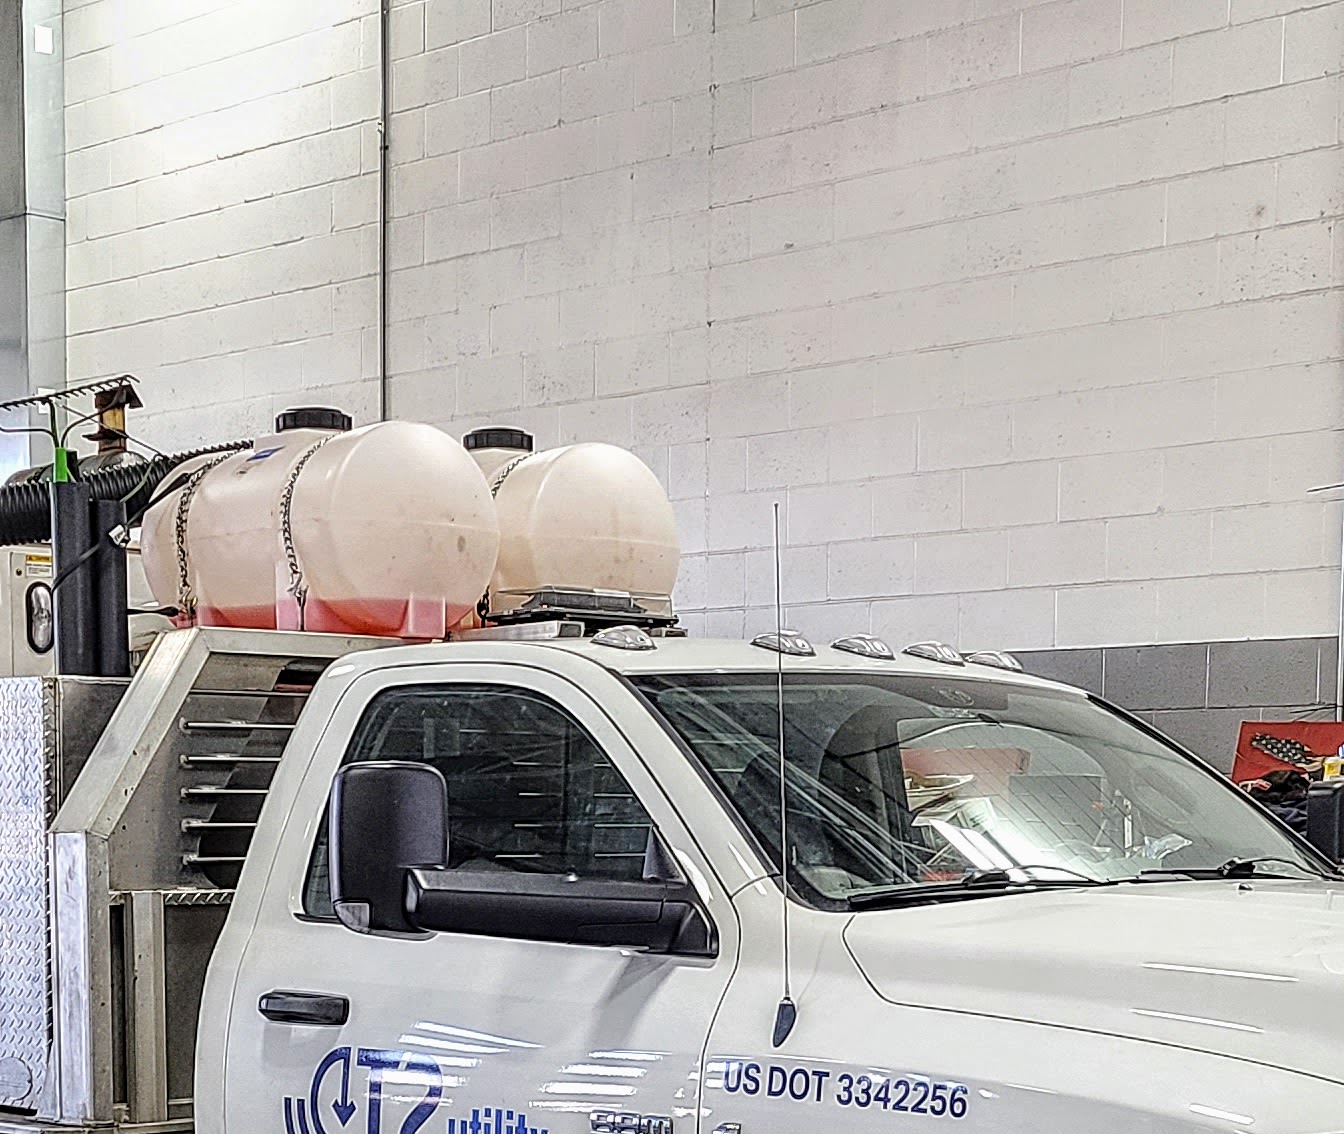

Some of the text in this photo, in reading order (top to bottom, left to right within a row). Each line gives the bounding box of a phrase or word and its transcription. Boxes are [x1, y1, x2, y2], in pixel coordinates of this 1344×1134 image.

[723, 1061, 969, 1118] US DOT 3342256
